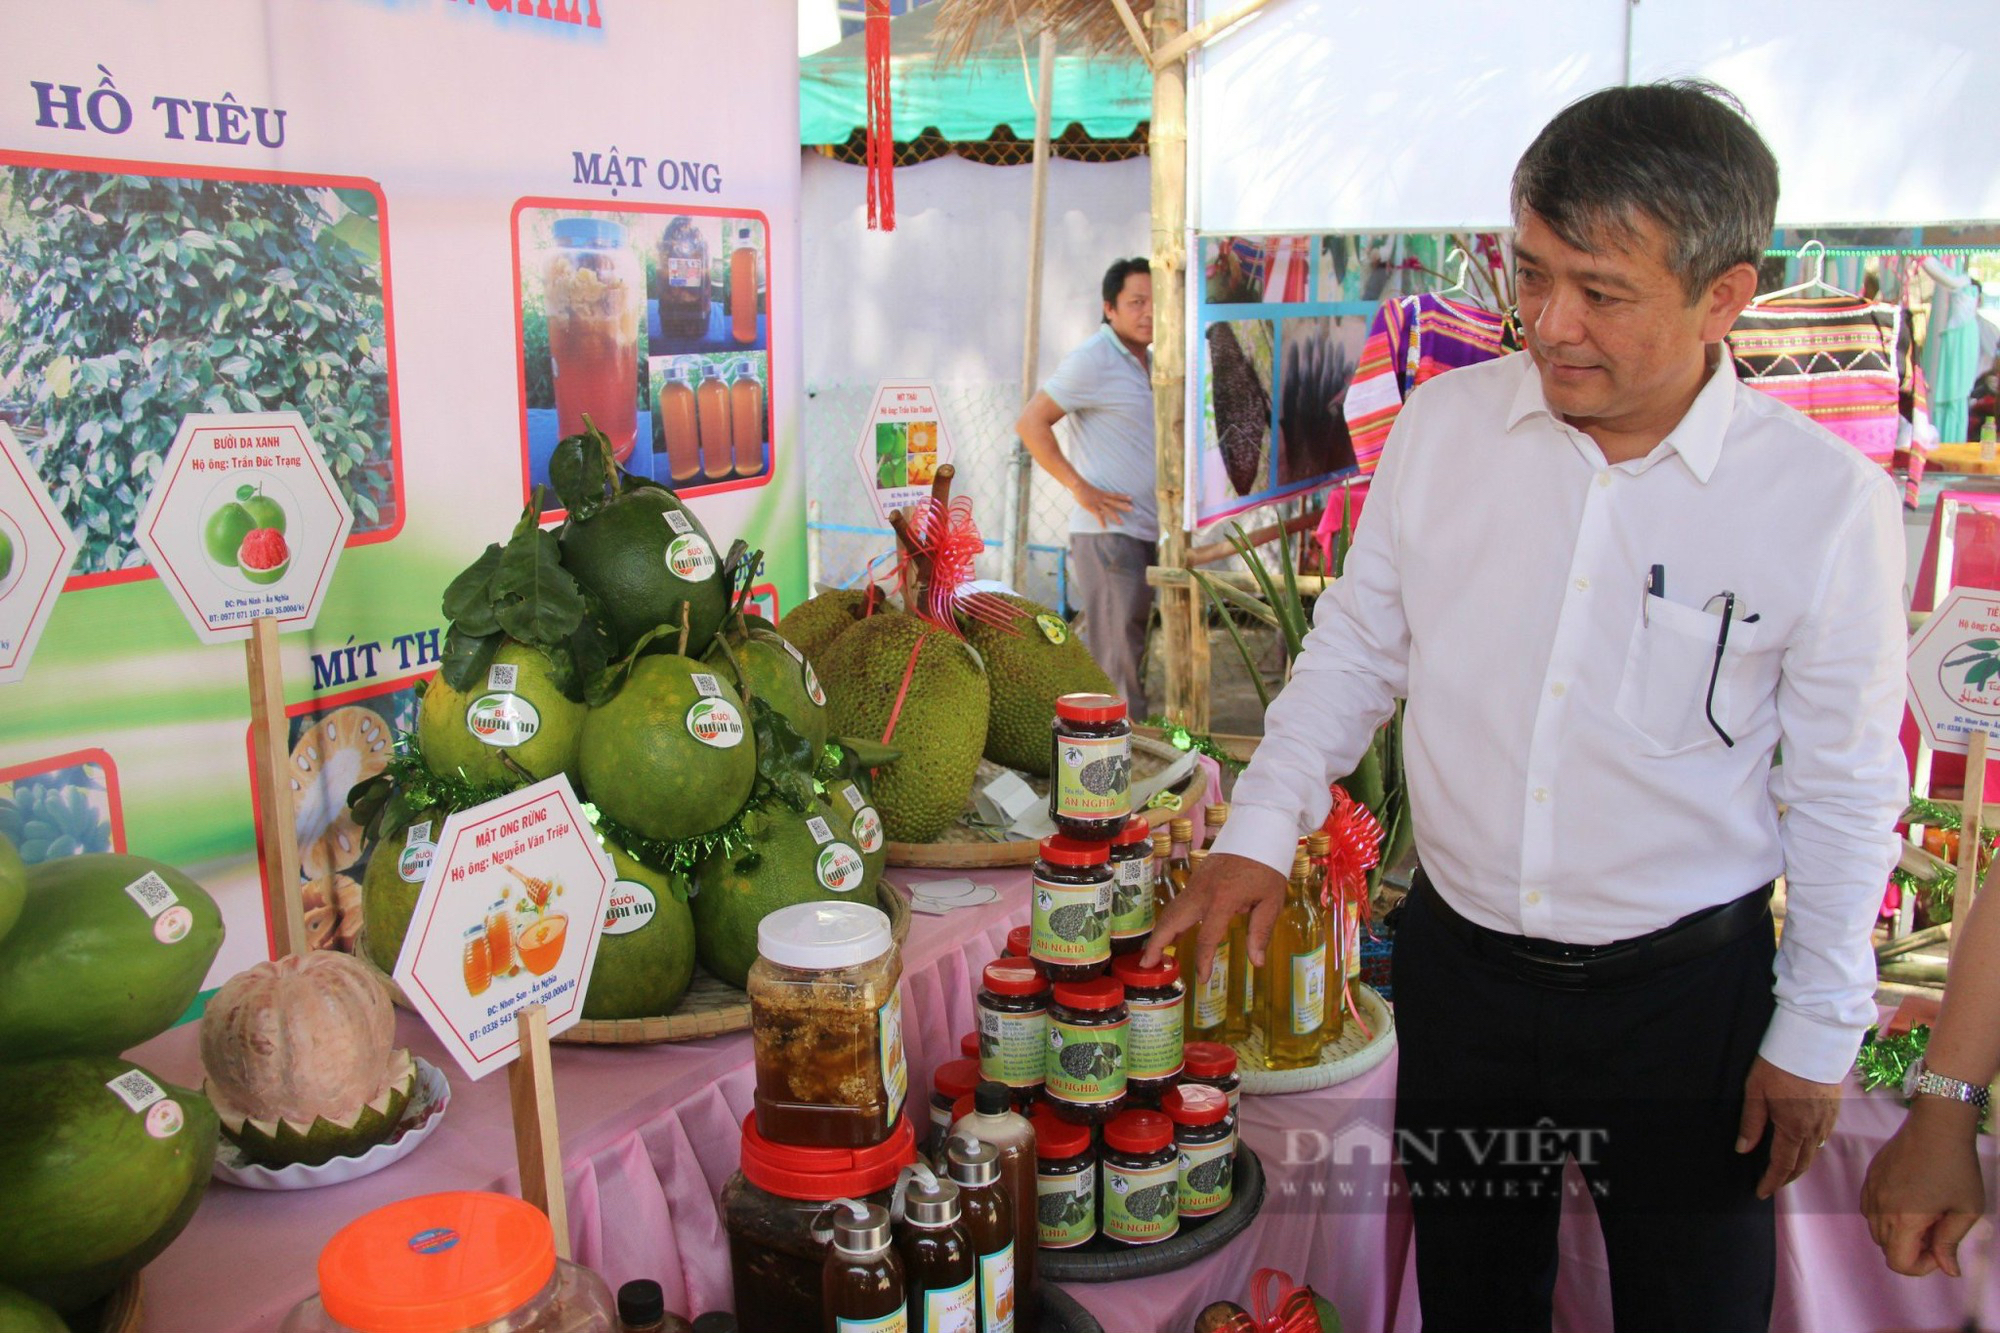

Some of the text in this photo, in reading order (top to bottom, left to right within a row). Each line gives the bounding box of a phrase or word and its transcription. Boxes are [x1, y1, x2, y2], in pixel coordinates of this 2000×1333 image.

[30, 64, 287, 148] HỒ TIÊU
[572, 145, 722, 197] MẬT ONG
[213, 434, 280, 449] BƯỞI DA XANH
[192, 455, 301, 473] Hộ ông: Trần Đức Trạng
[310, 628, 441, 691] MÍT TH
[475, 808, 547, 848] MẬT ONG RỪNG
[451, 823, 569, 882] Hộ ông: Nguyễn Văn Triệu
[469, 1030, 482, 1042] ĐT:
[482, 1020, 499, 1035] 0338
[500, 1013, 512, 1026] 543
[487, 1005, 499, 1017] ĐC:
